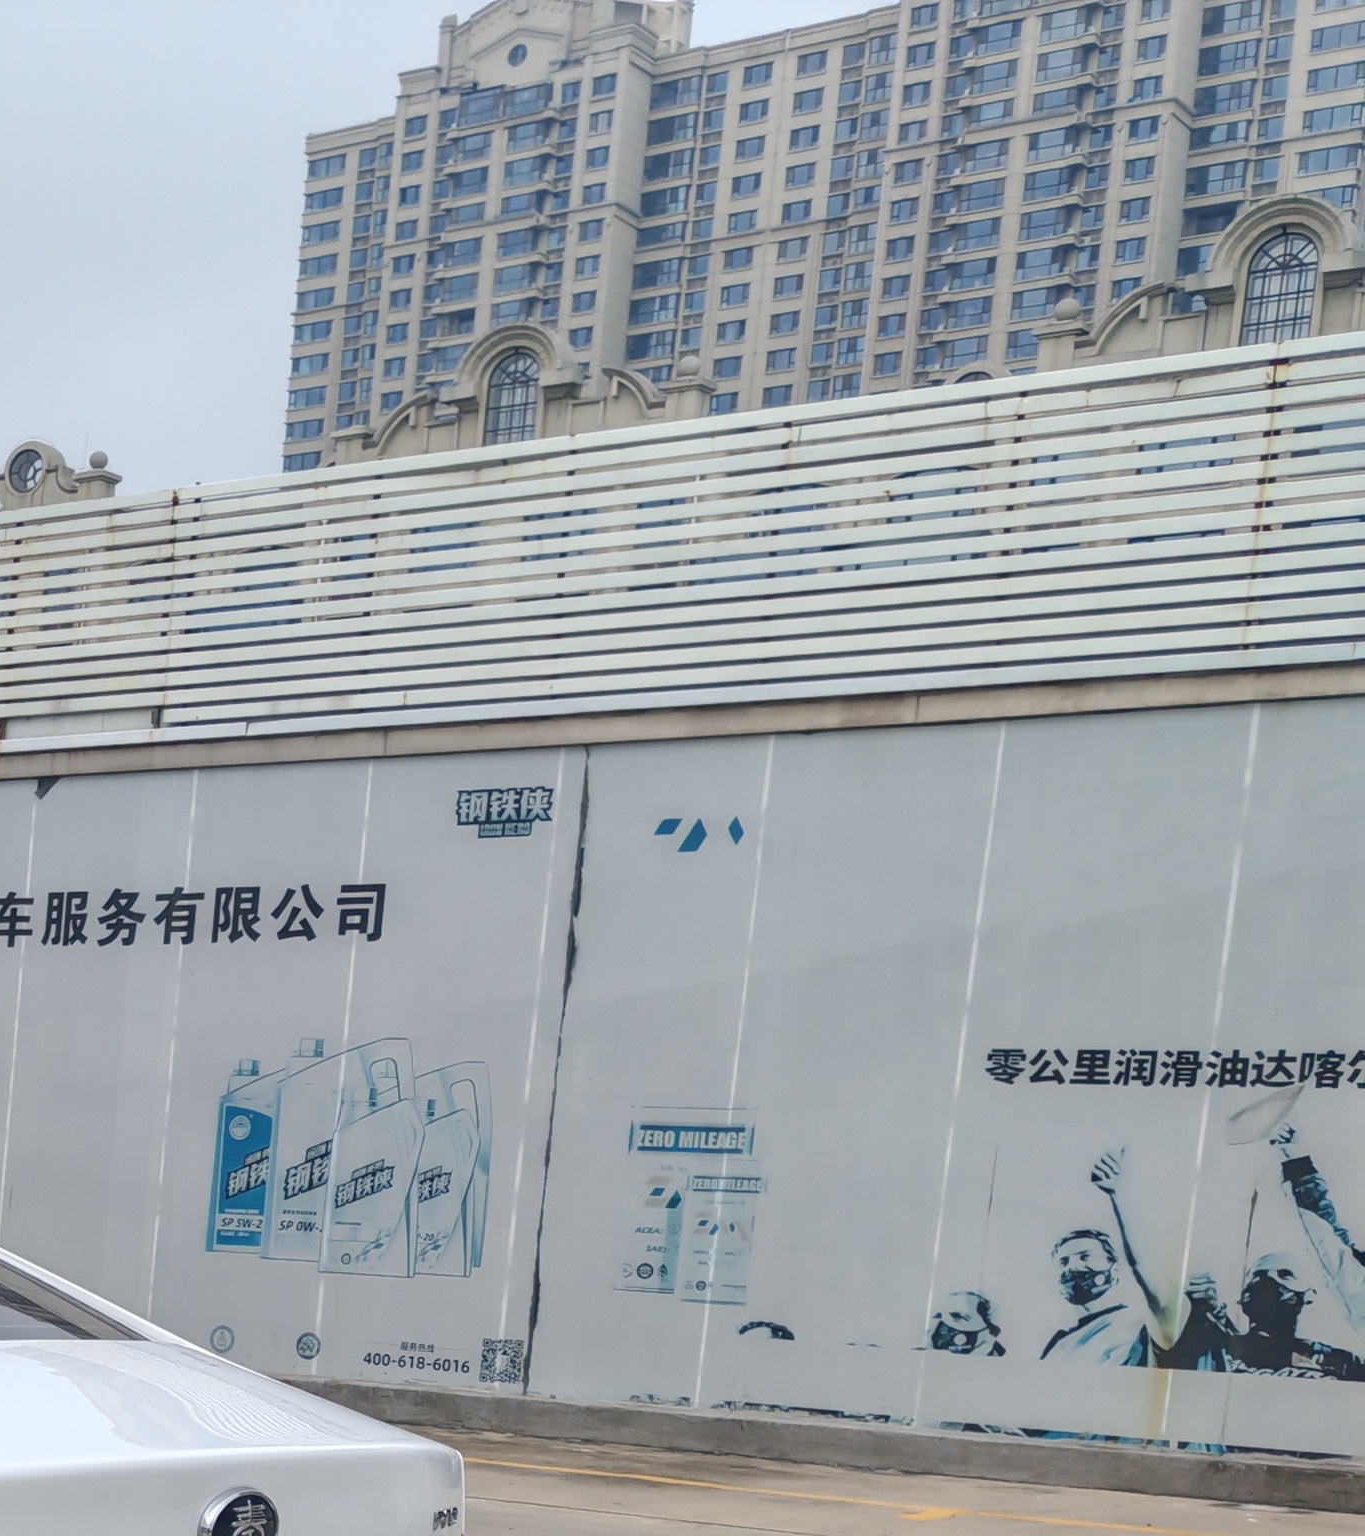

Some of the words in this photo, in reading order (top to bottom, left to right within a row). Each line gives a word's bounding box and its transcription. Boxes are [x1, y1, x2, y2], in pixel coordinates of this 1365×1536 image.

[457, 788, 553, 824] 钢铁侠
[638, 1130, 675, 1148] ZERO
[679, 1131, 747, 1150] MILEAGE
[336, 1168, 394, 1208] 钢铁侠
[221, 1217, 234, 1227] SP
[278, 1219, 294, 1231] SP
[295, 1221, 323, 1234] 0W-
[400, 1342, 435, 1354] 服务热线
[363, 1352, 470, 1374] 400-618-6016
